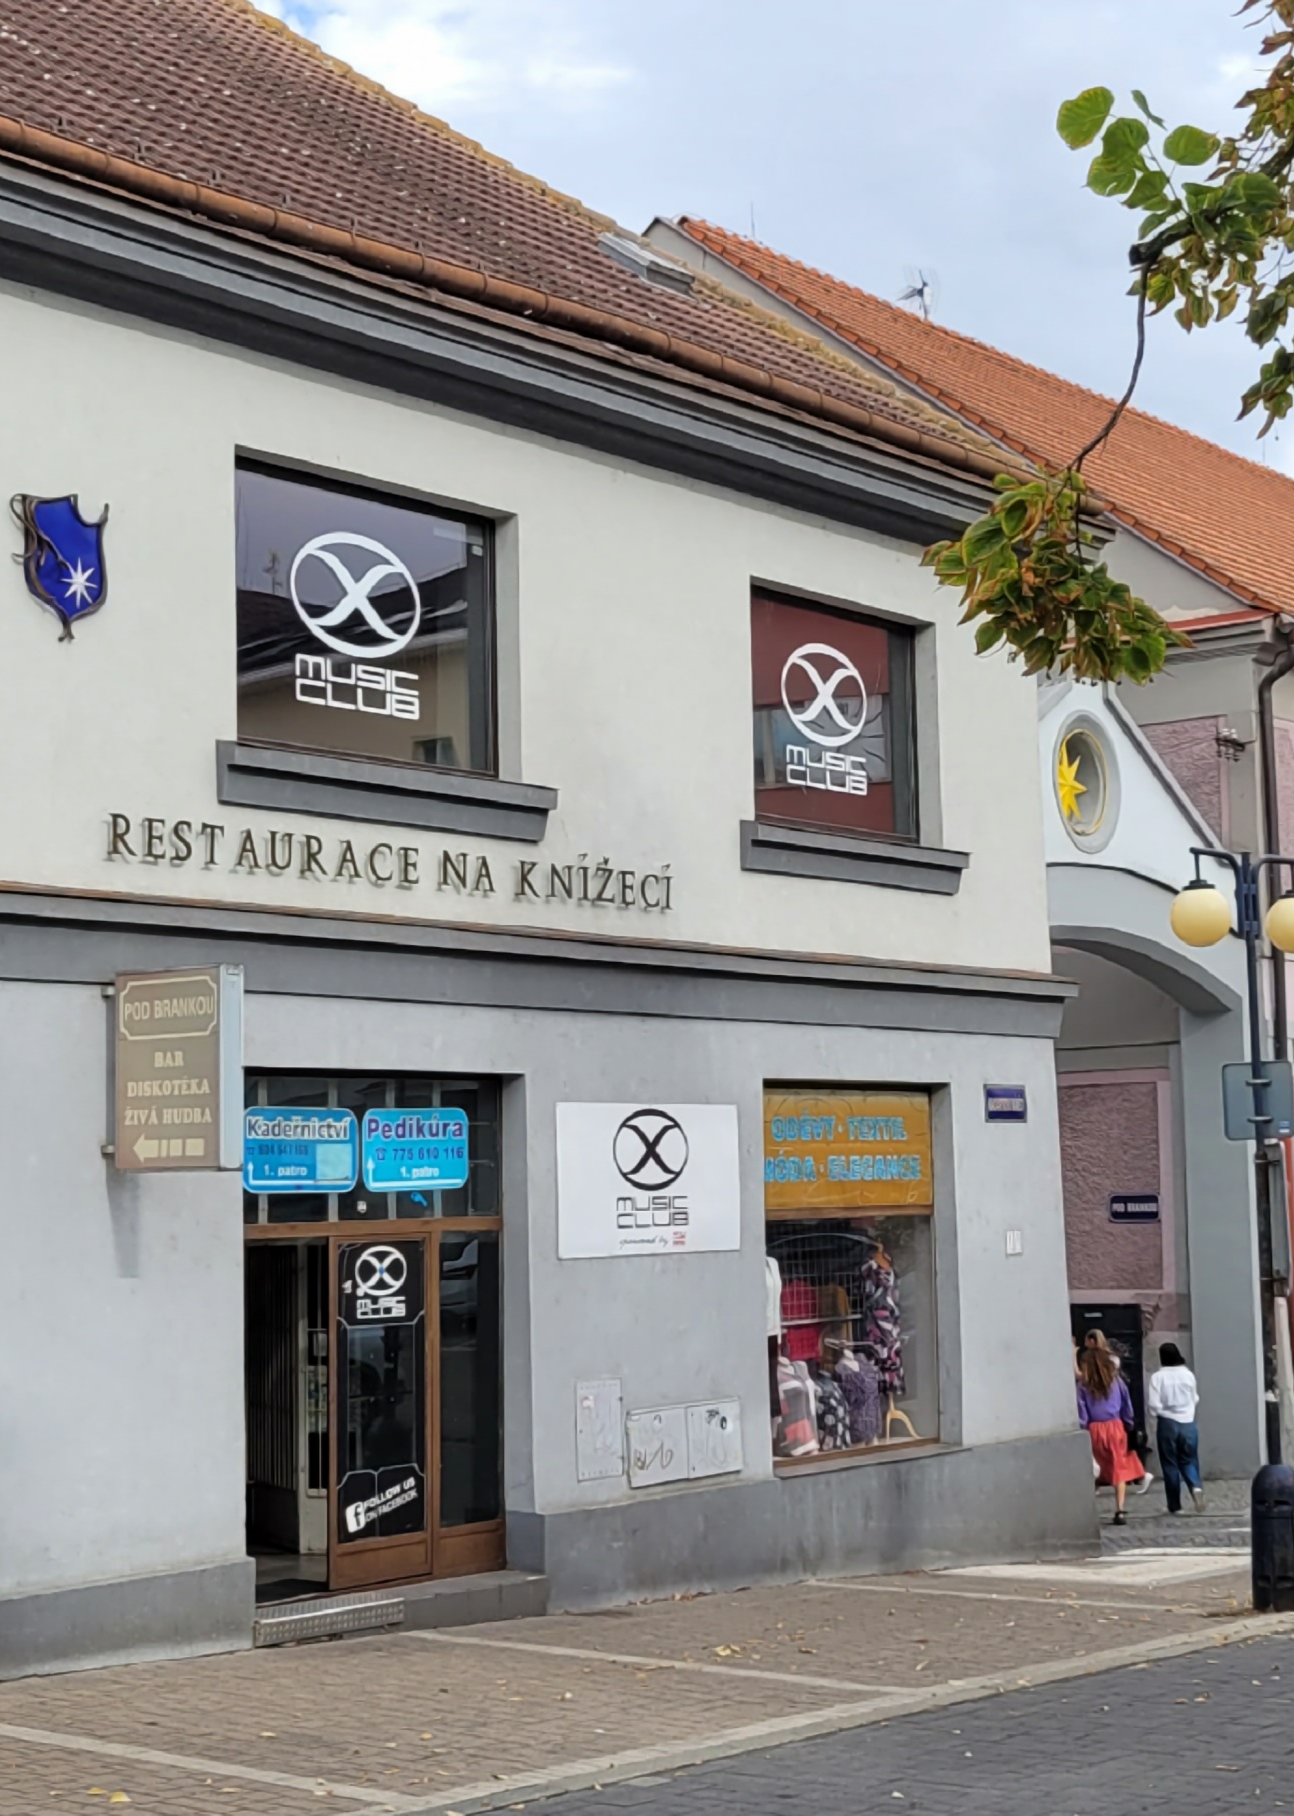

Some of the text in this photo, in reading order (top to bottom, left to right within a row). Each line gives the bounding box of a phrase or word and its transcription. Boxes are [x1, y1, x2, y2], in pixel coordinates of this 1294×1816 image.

[296, 653, 419, 696] MUSIC
[296, 678, 420, 720] CLUB
[786, 744, 867, 776] MUSIC
[786, 764, 868, 796] CLUB
[106, 813, 675, 911] RESTAURACE NA KNÍŽECÍ
[124, 996, 215, 1021] POD BRANKOU
[154, 1051, 184, 1068] BAR
[126, 1076, 211, 1098] DISKOTÉKA
[124, 1105, 213, 1126] ŽIVÁ HUDBA
[246, 1115, 353, 1140] Kadeřnictví
[366, 1115, 464, 1140] Pedikúra
[846, 1115, 908, 1141] TEXTIL
[277, 1165, 308, 1178] patro
[411, 1165, 439, 1179] patro
[827, 1154, 922, 1182] ELEGANCE
[616, 1195, 689, 1211] MUSIC
[616, 1210, 690, 1230] CLUB
